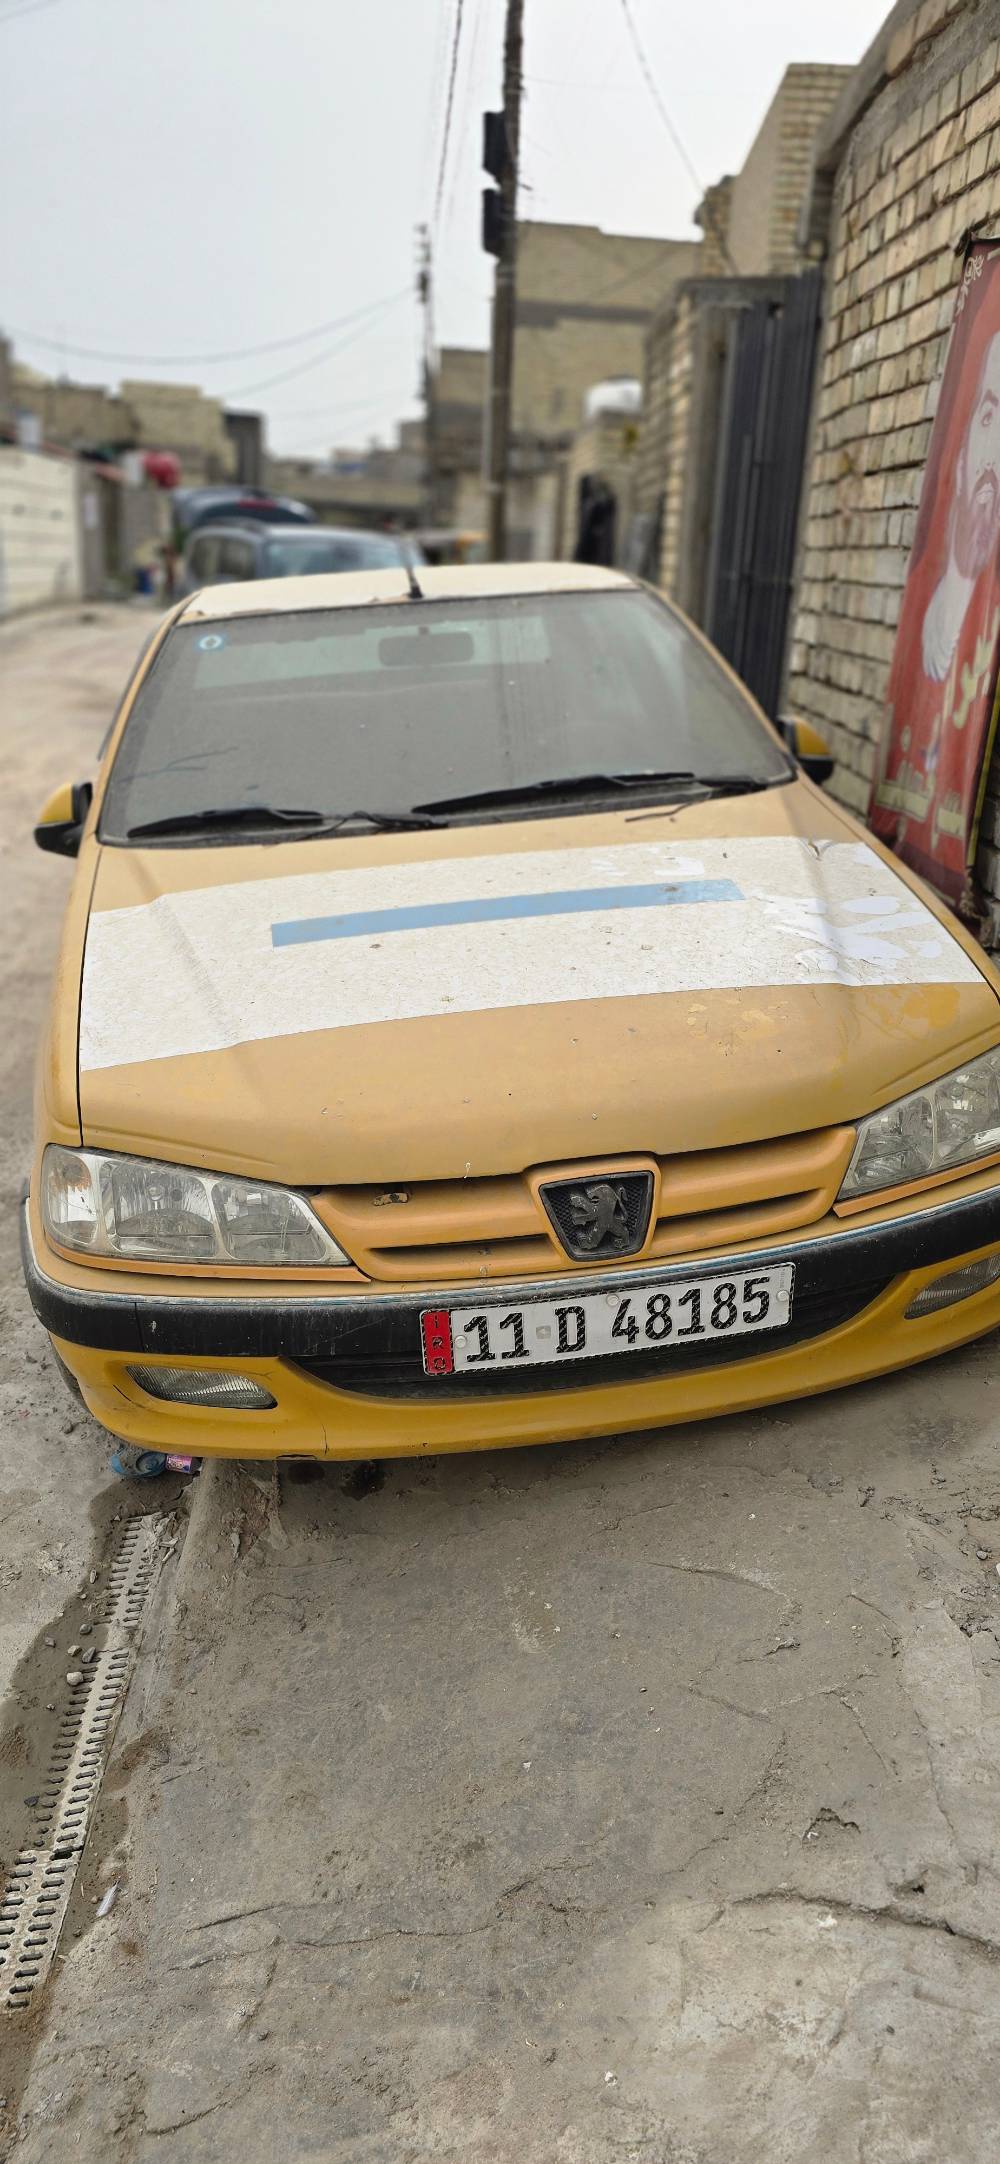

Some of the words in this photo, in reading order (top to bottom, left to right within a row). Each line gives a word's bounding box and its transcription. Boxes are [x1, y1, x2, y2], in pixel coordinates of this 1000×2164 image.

[464, 1312, 530, 1362] 11
[555, 1306, 586, 1353] D
[611, 1276, 770, 1344] 48185
